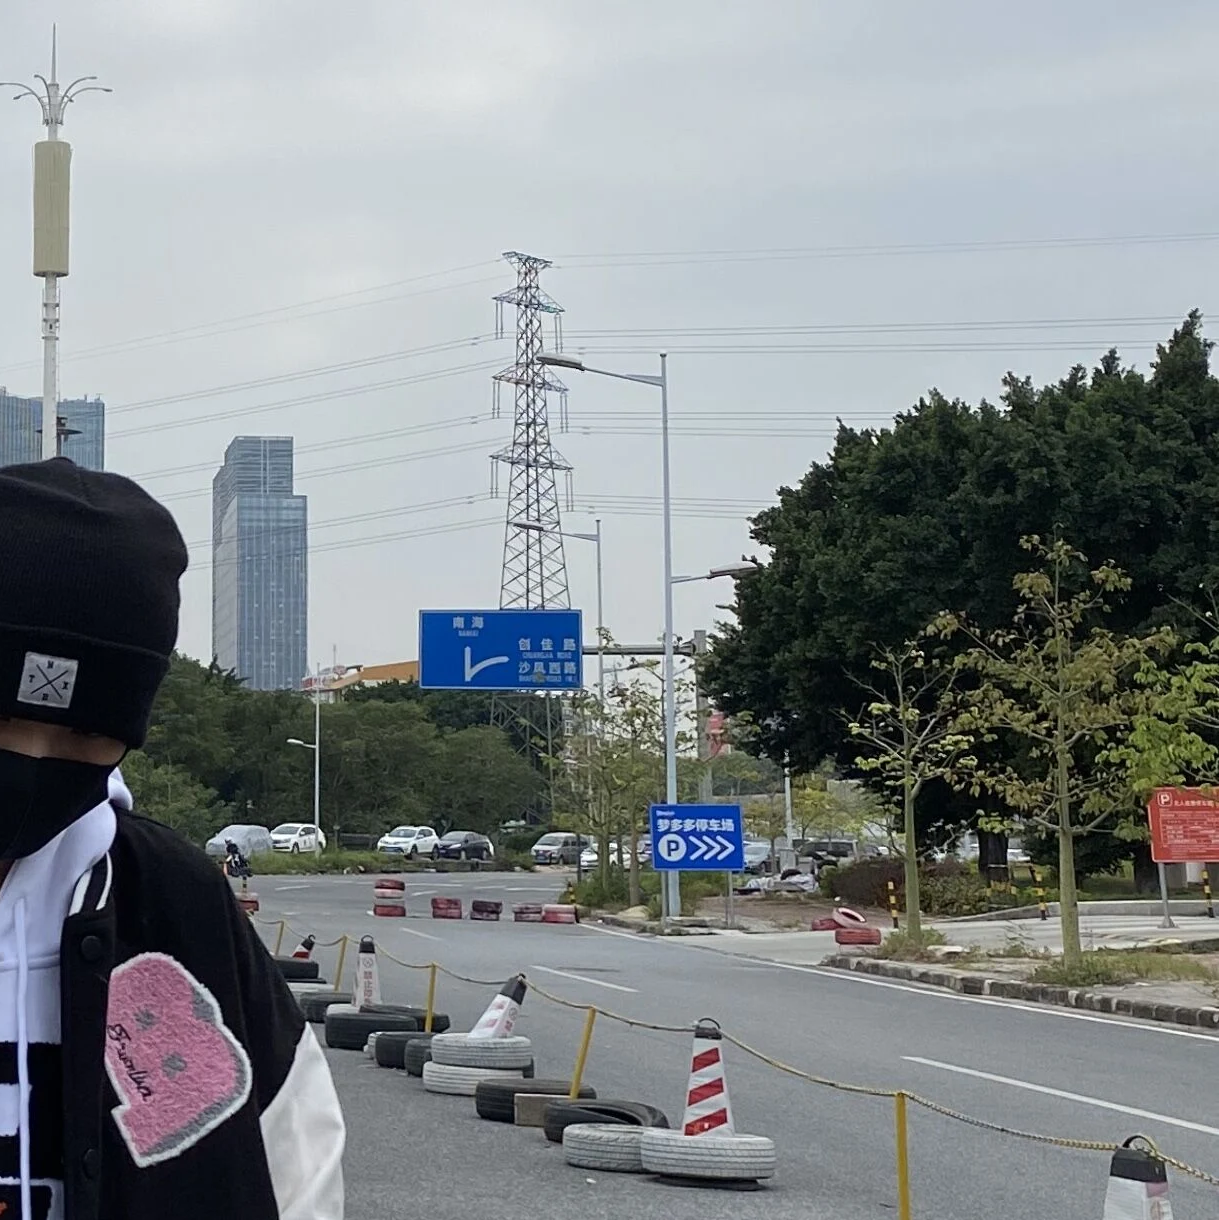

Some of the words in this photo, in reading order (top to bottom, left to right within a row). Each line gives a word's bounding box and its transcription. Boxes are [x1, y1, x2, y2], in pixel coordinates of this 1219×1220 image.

[453, 616, 484, 629] 南海
[28, 674, 36, 683] T
[657, 818, 735, 833] 梦多多停车场
[667, 840, 679, 857] P
